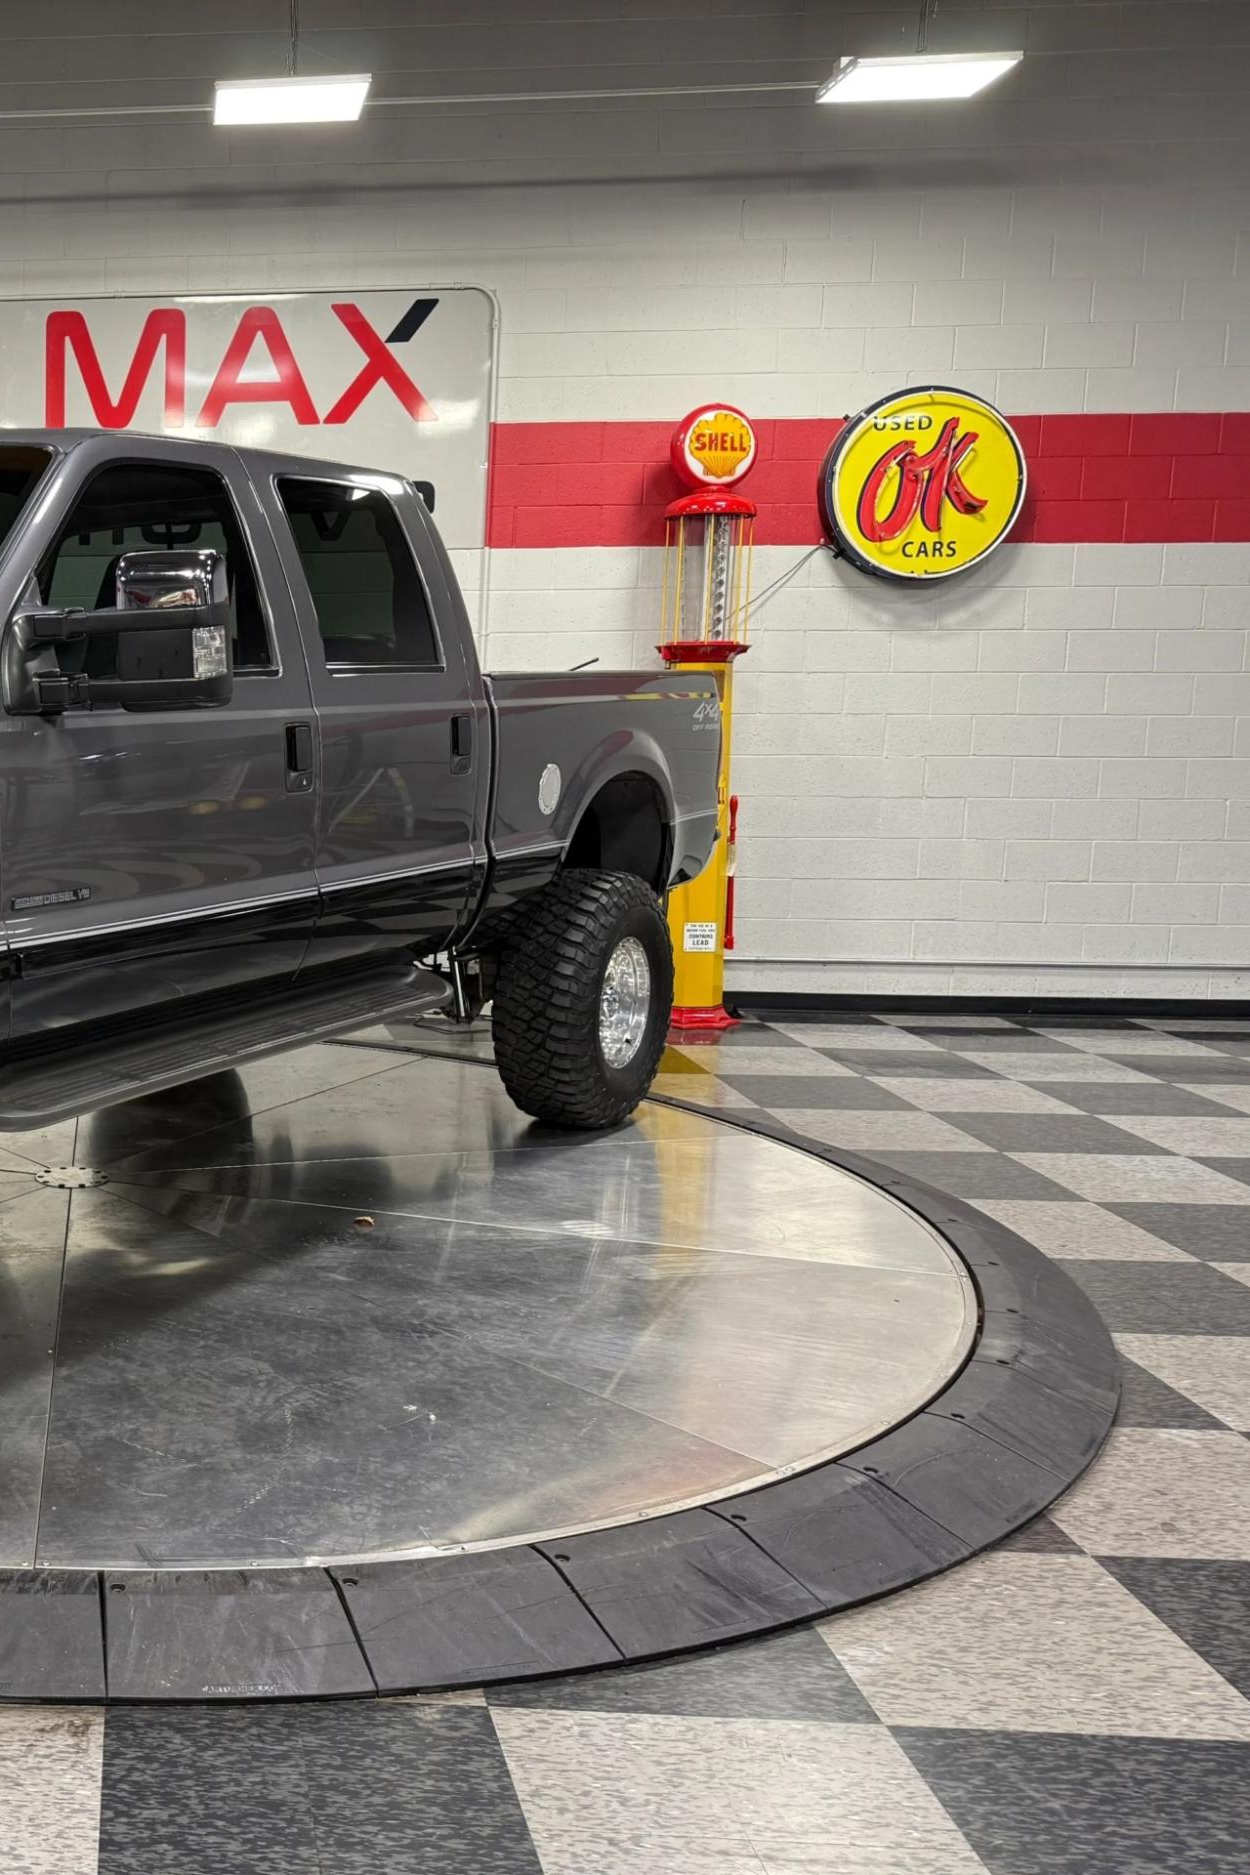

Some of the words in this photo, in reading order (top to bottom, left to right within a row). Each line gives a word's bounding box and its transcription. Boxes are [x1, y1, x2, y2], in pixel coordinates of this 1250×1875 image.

[46, 299, 440, 428] MAX
[873, 415, 934, 432] USED
[694, 429, 748, 454] SHELL
[856, 416, 989, 543] OK
[901, 540, 958, 559] CARS
